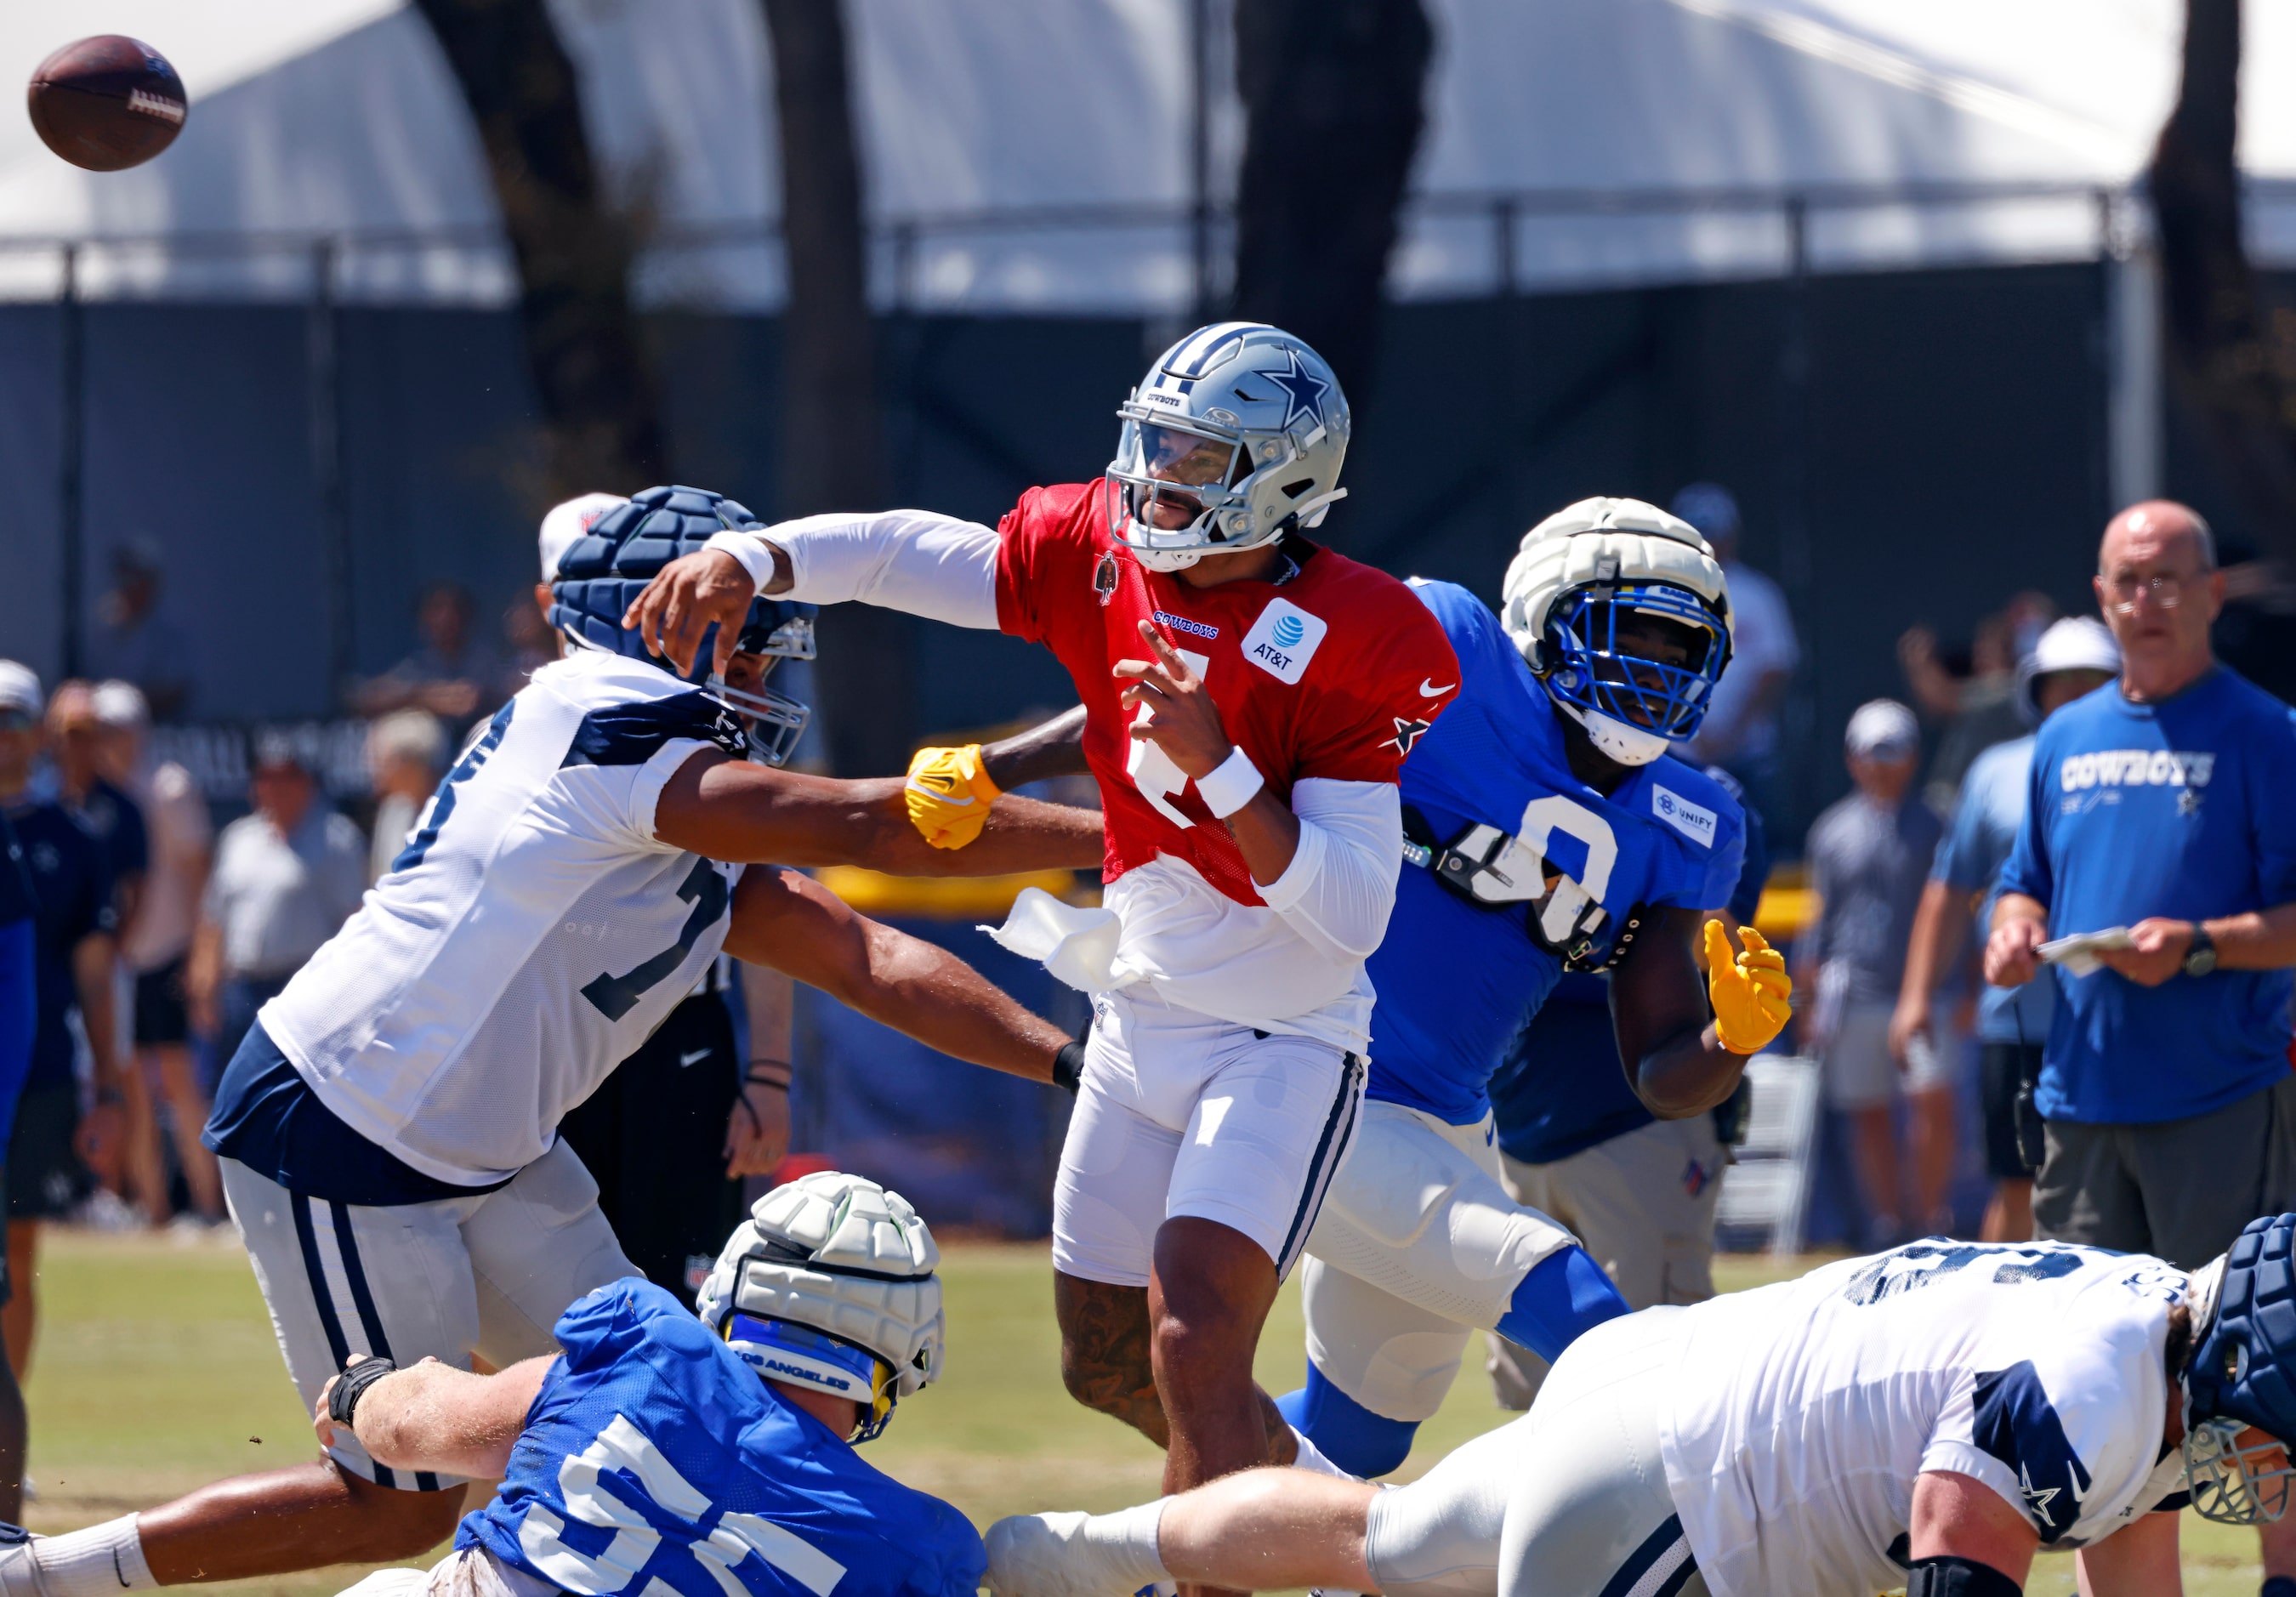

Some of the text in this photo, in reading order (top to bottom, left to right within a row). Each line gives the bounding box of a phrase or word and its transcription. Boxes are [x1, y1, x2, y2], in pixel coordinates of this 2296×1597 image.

[1147, 393, 1180, 406] COWBOYS
[1153, 610, 1219, 640] COWBOYS
[1253, 643, 1293, 671] AT&T
[2061, 747, 2216, 793] COWBOYS
[1679, 807, 1712, 830] UNIFY
[580, 855, 736, 1022] 7
[765, 1359, 850, 1391] ANGELES
